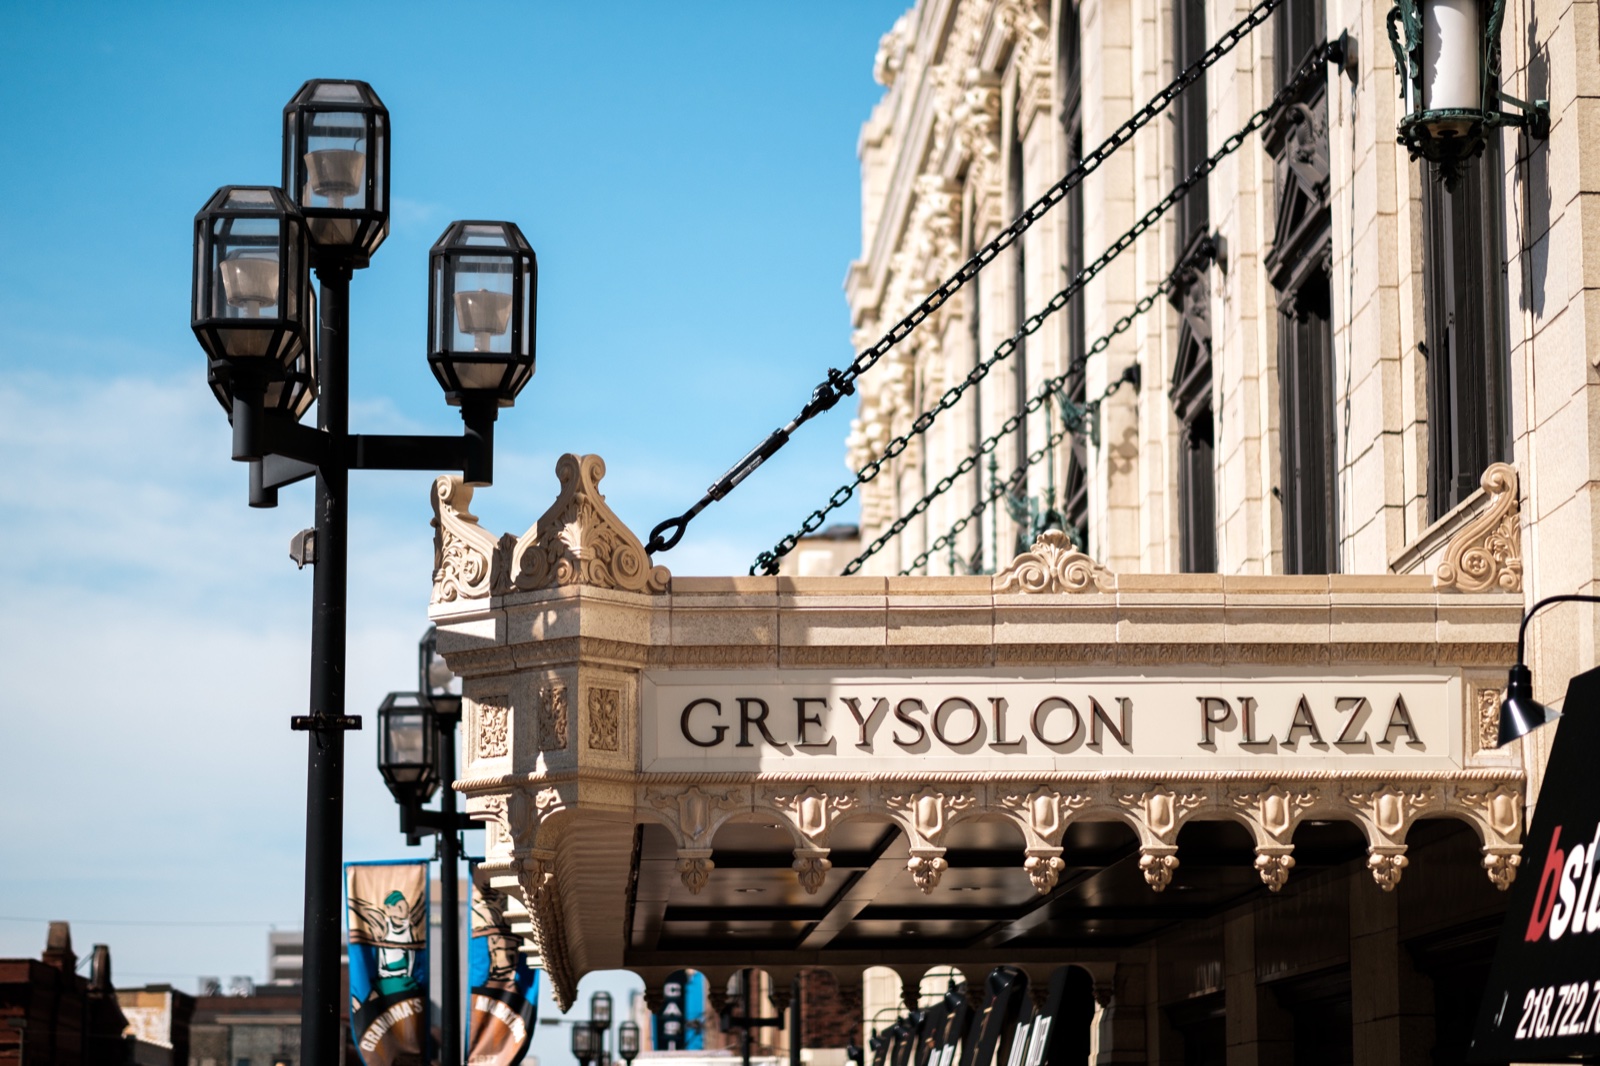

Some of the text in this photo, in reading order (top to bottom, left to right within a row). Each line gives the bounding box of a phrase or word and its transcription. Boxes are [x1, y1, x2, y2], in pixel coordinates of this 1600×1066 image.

[680, 693, 1424, 748] GREYSOLON PLAZA
[360, 998, 423, 1052] GRANDMA'S
